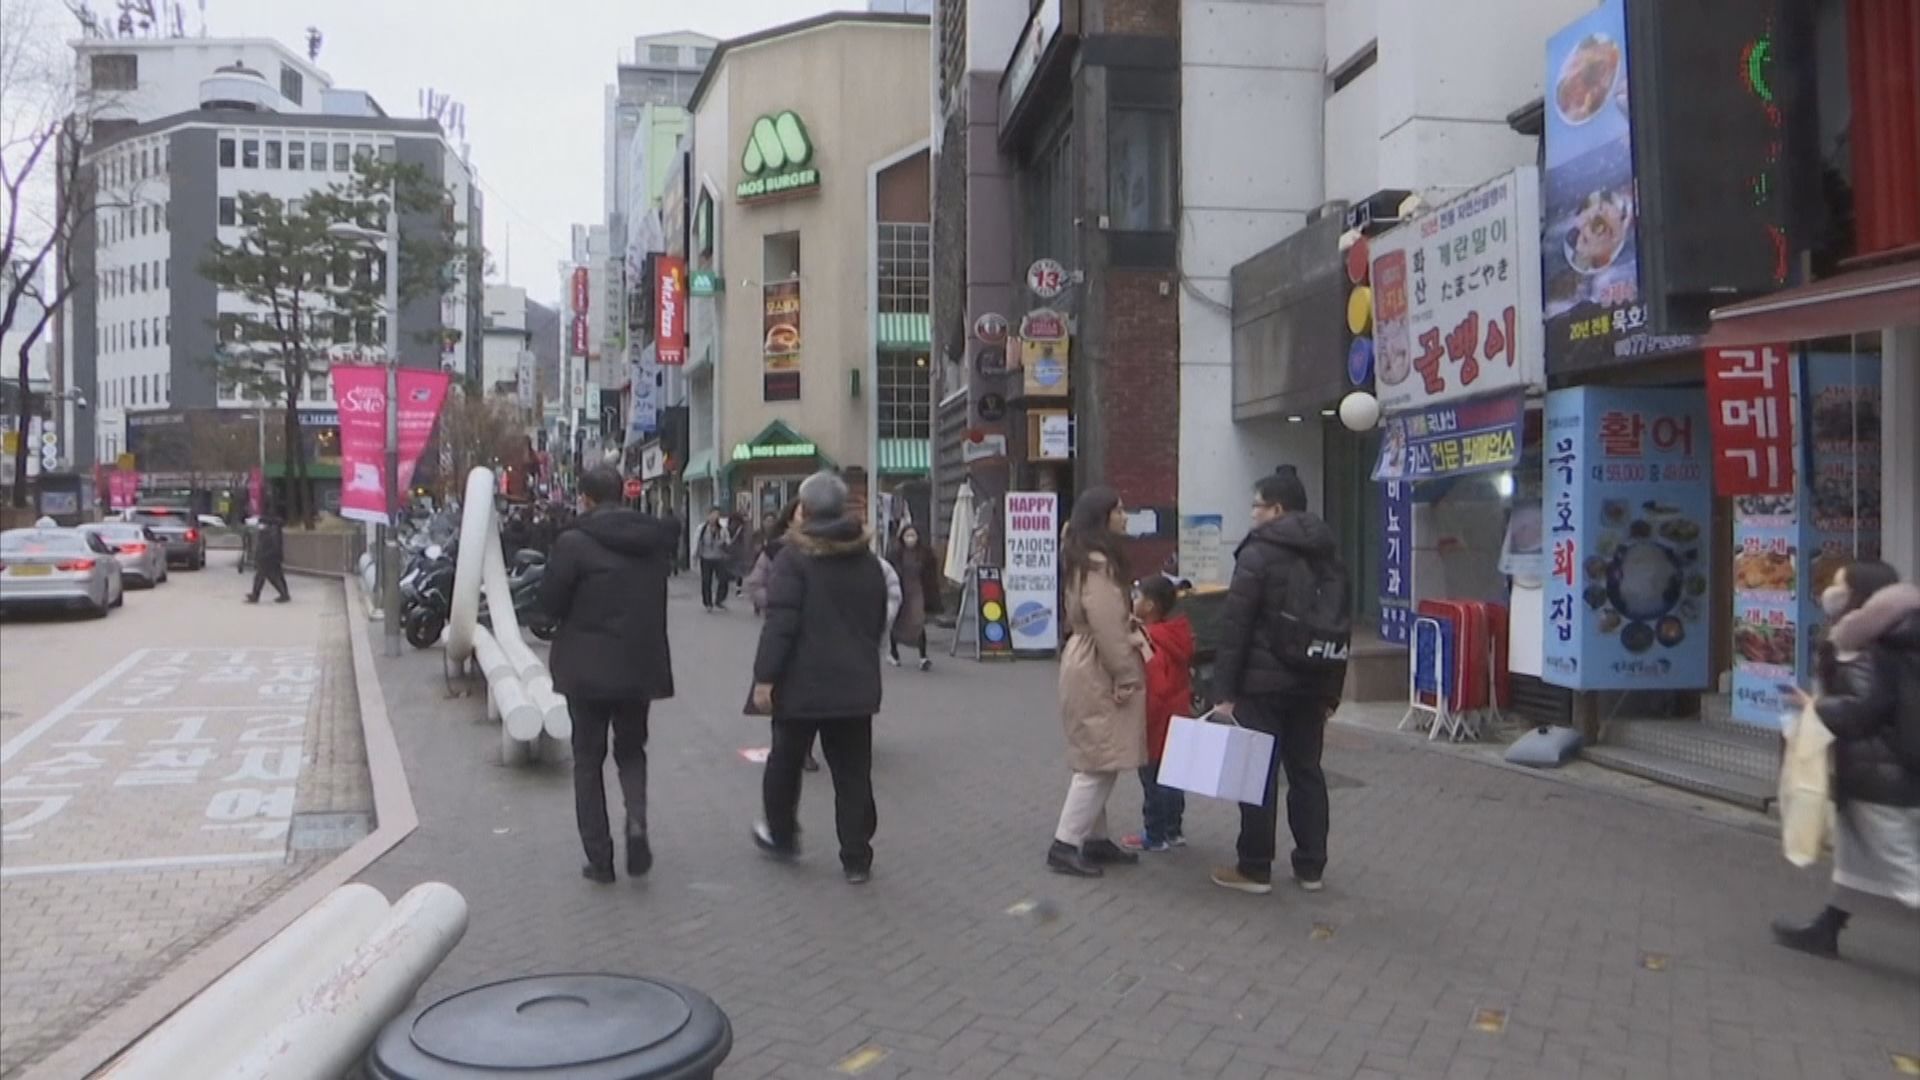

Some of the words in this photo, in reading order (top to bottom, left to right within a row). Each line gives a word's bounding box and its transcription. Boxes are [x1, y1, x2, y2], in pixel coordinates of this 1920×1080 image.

[737, 180, 764, 196] MOS
[766, 170, 815, 192] BURGER
[1441, 257, 1508, 301] たまごやき
[1413, 305, 1516, 395] 골뱅이
[1718, 347, 1779, 488] 과메기
[1600, 412, 1692, 457] 활어
[752, 445, 774, 457] MOS
[775, 443, 815, 456] BURGER
[1009, 498, 1054, 512] HAPPY
[1012, 516, 1051, 531] HOUR
[1306, 640, 1348, 660] FILA
